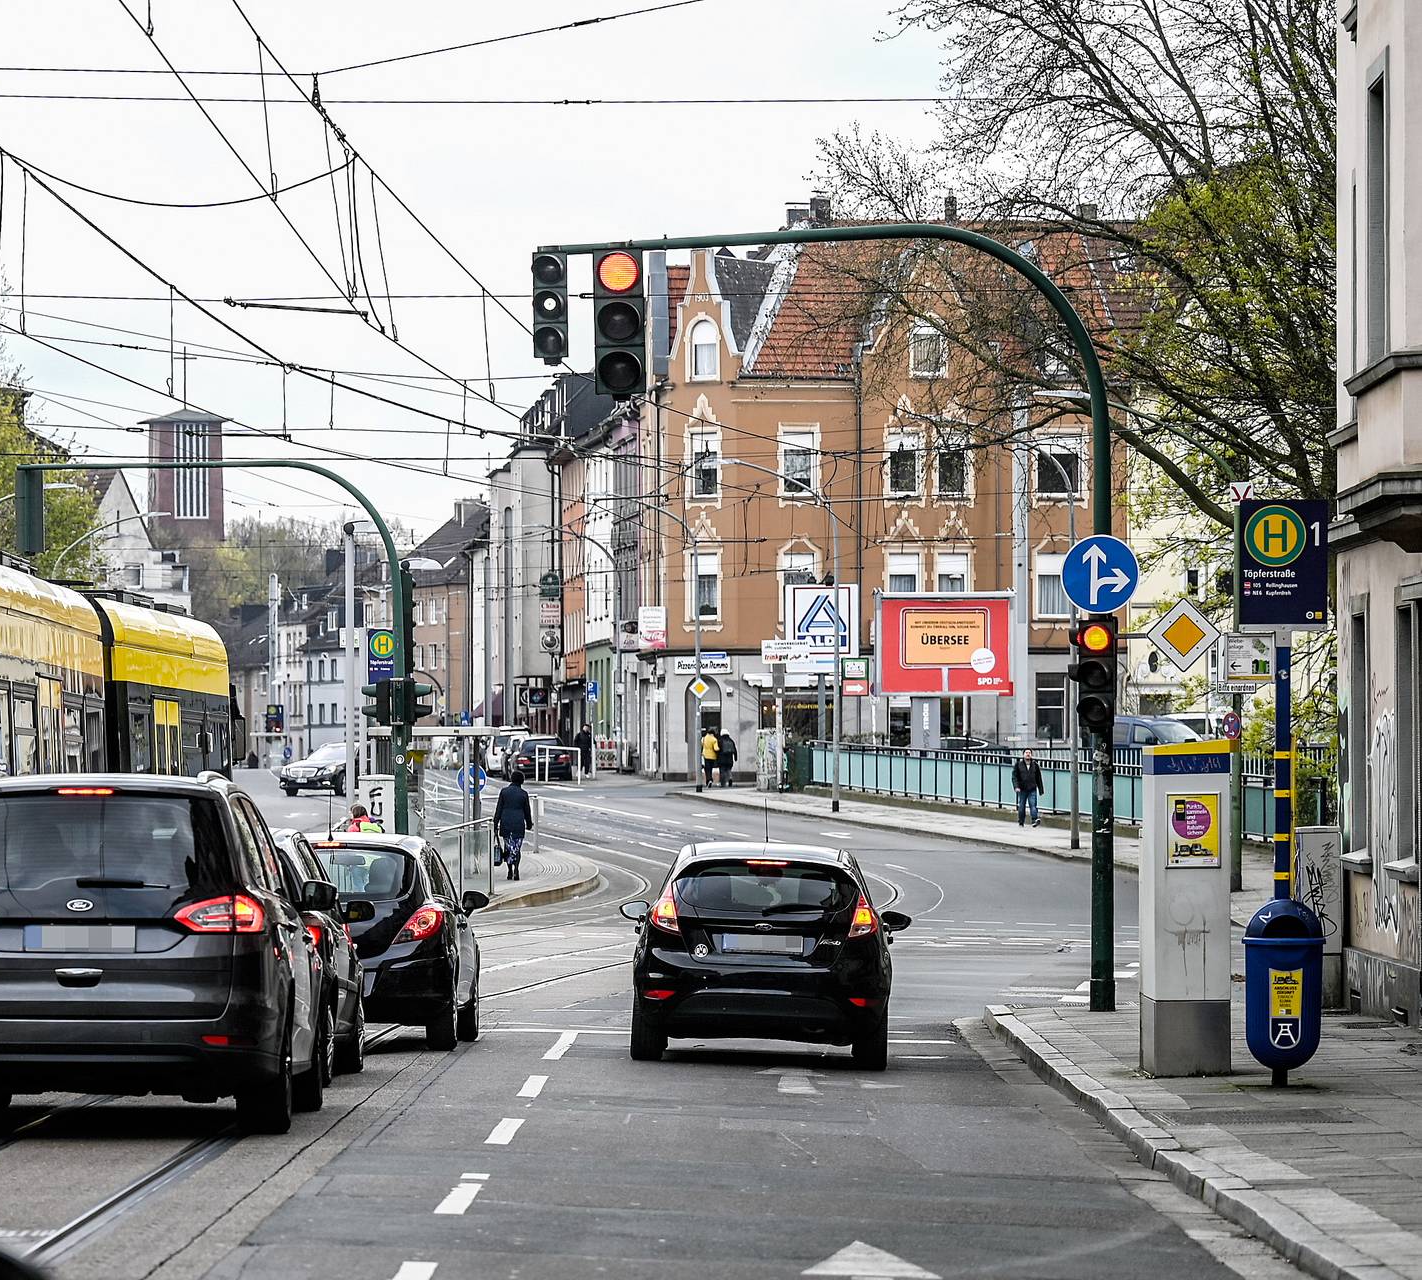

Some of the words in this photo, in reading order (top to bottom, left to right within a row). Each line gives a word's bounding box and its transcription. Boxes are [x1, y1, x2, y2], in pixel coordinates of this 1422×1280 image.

[1310, 521, 1320, 547] 1
[1243, 568, 1296, 580] Töpferstraße
[921, 633, 969, 645] ÜBERSEE
[1230, 684, 1255, 692] einordnen
